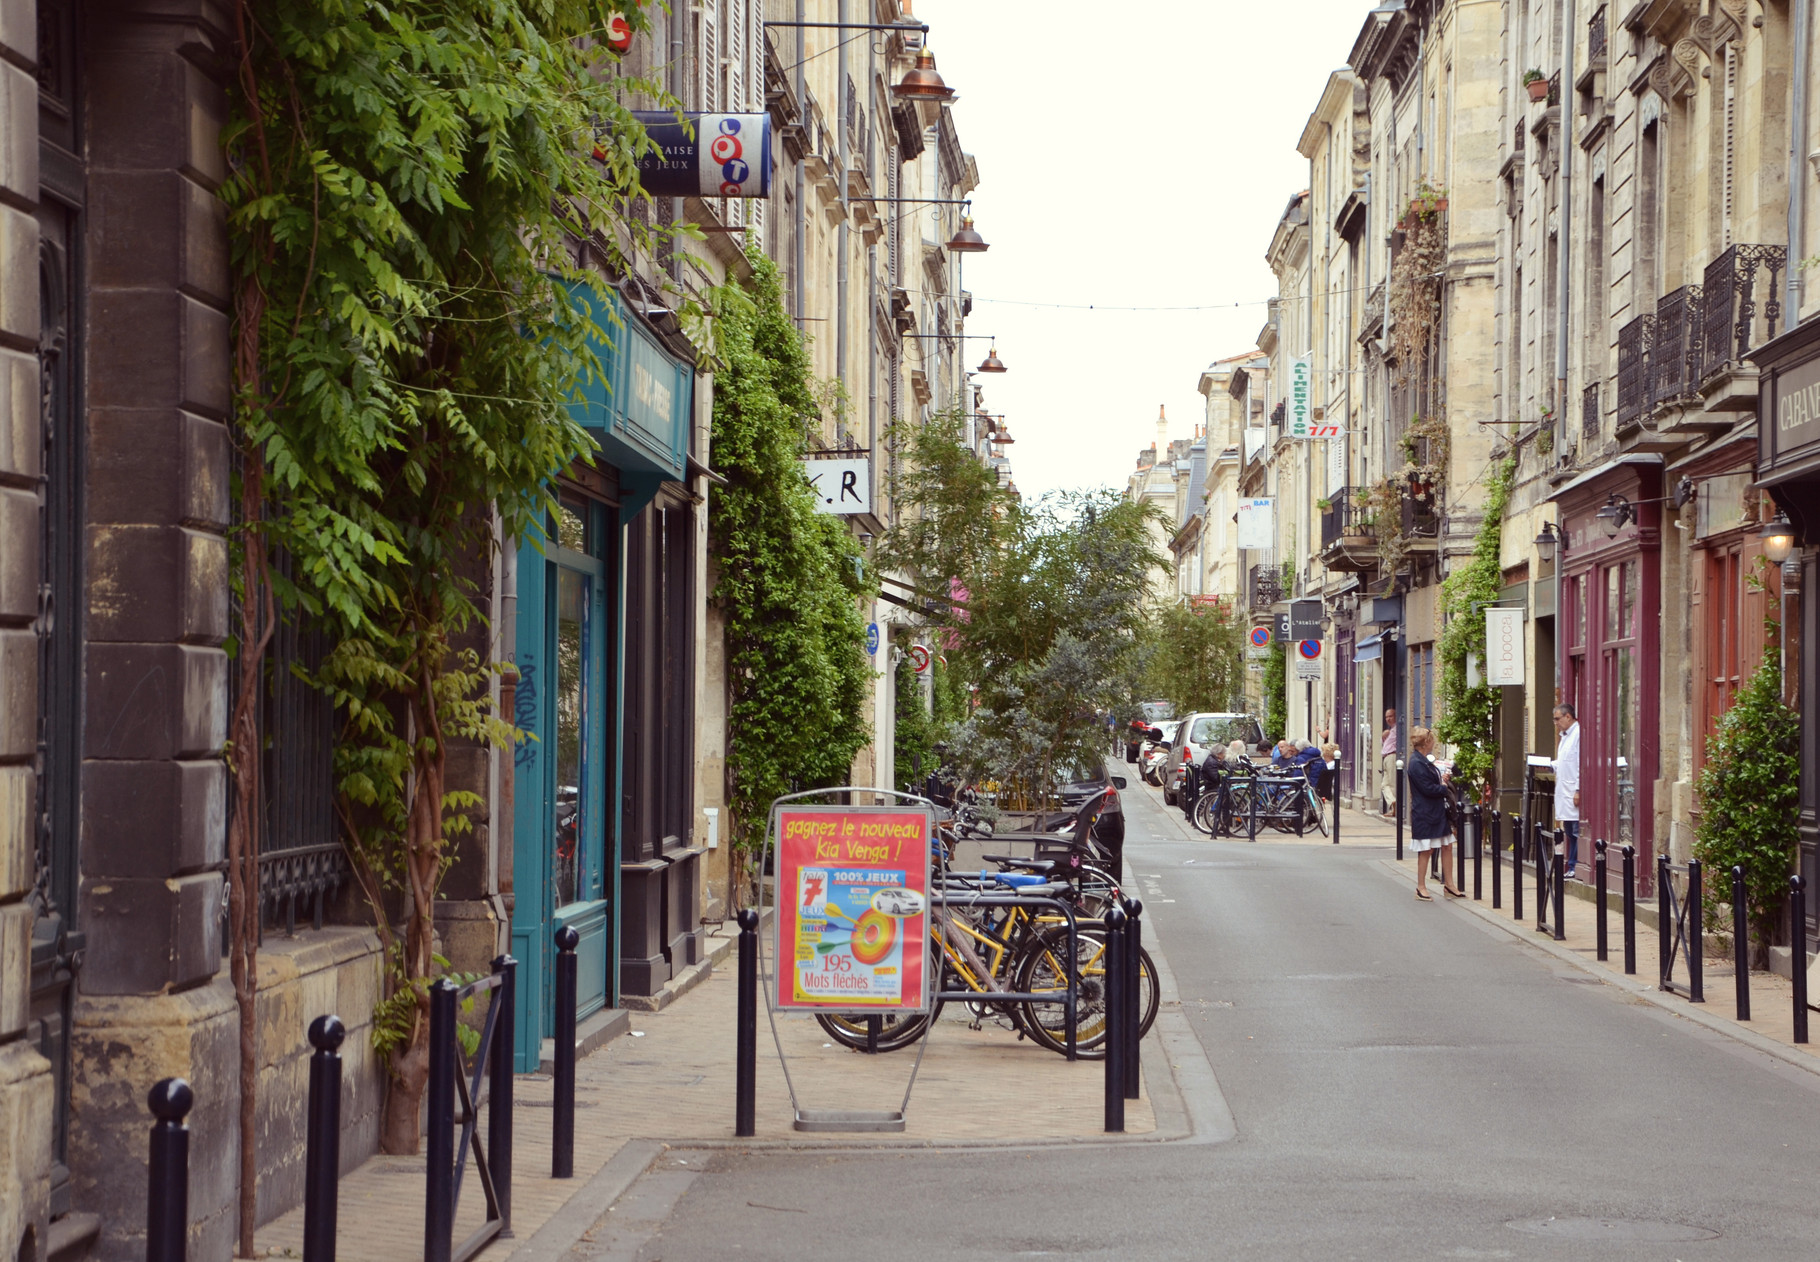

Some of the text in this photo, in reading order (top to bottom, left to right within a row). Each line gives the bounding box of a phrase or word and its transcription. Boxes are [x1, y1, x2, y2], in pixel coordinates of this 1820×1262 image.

[657, 160, 688, 170] JEUX
[1293, 362, 1308, 434] ALIMENTATION
[1309, 426, 1339, 436] 7/7
[1500, 614, 1513, 679] la bocca
[786, 817, 920, 839] gagnez le nouveau
[847, 840, 889, 864] Venga
[833, 871, 899, 883] 100% JEUX
[822, 954, 851, 972] 195
[804, 972, 830, 988] Mots
[833, 972, 869, 990] fléchés
